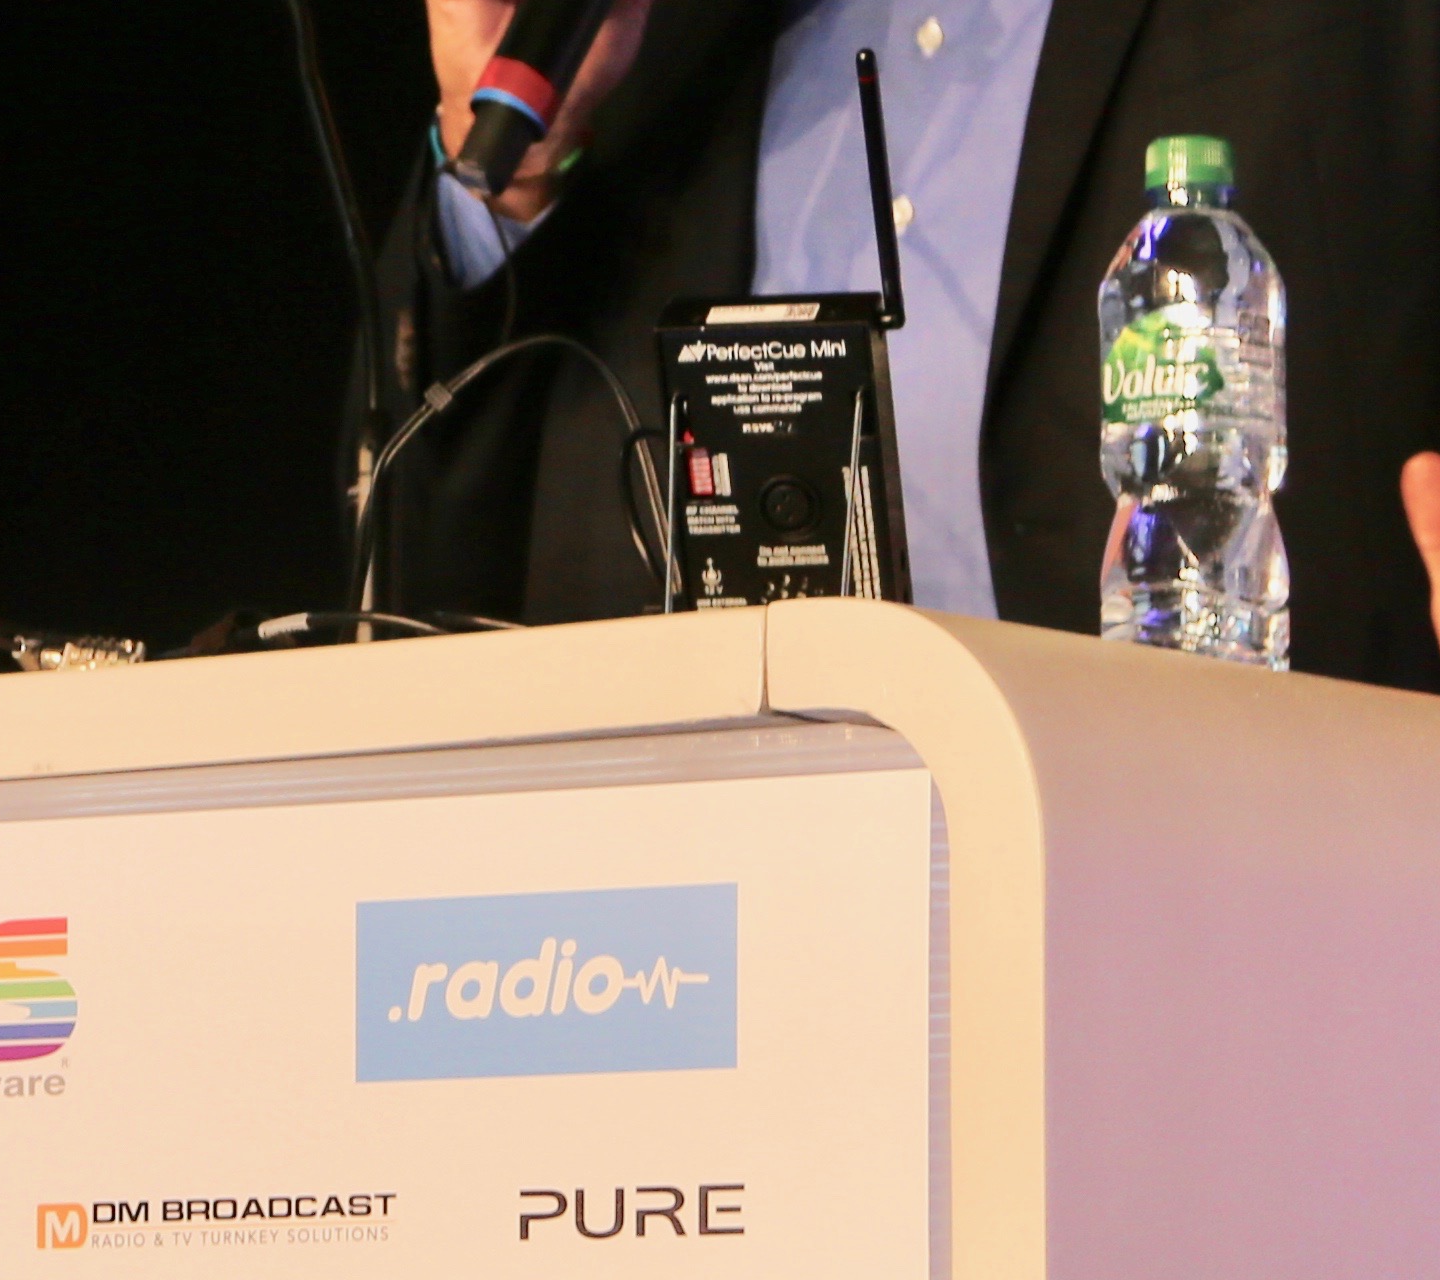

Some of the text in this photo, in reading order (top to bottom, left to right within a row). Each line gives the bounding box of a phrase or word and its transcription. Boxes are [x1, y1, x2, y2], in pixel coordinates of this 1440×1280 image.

[707, 339, 847, 361] PerfectCue Mini
[93, 1201, 149, 1223] DM
[161, 1193, 396, 1221] BROADCAST
[519, 1183, 745, 1239] PURE
[92, 1226, 389, 1249] RADIO & TV TURNKEY SOLUTIONS
